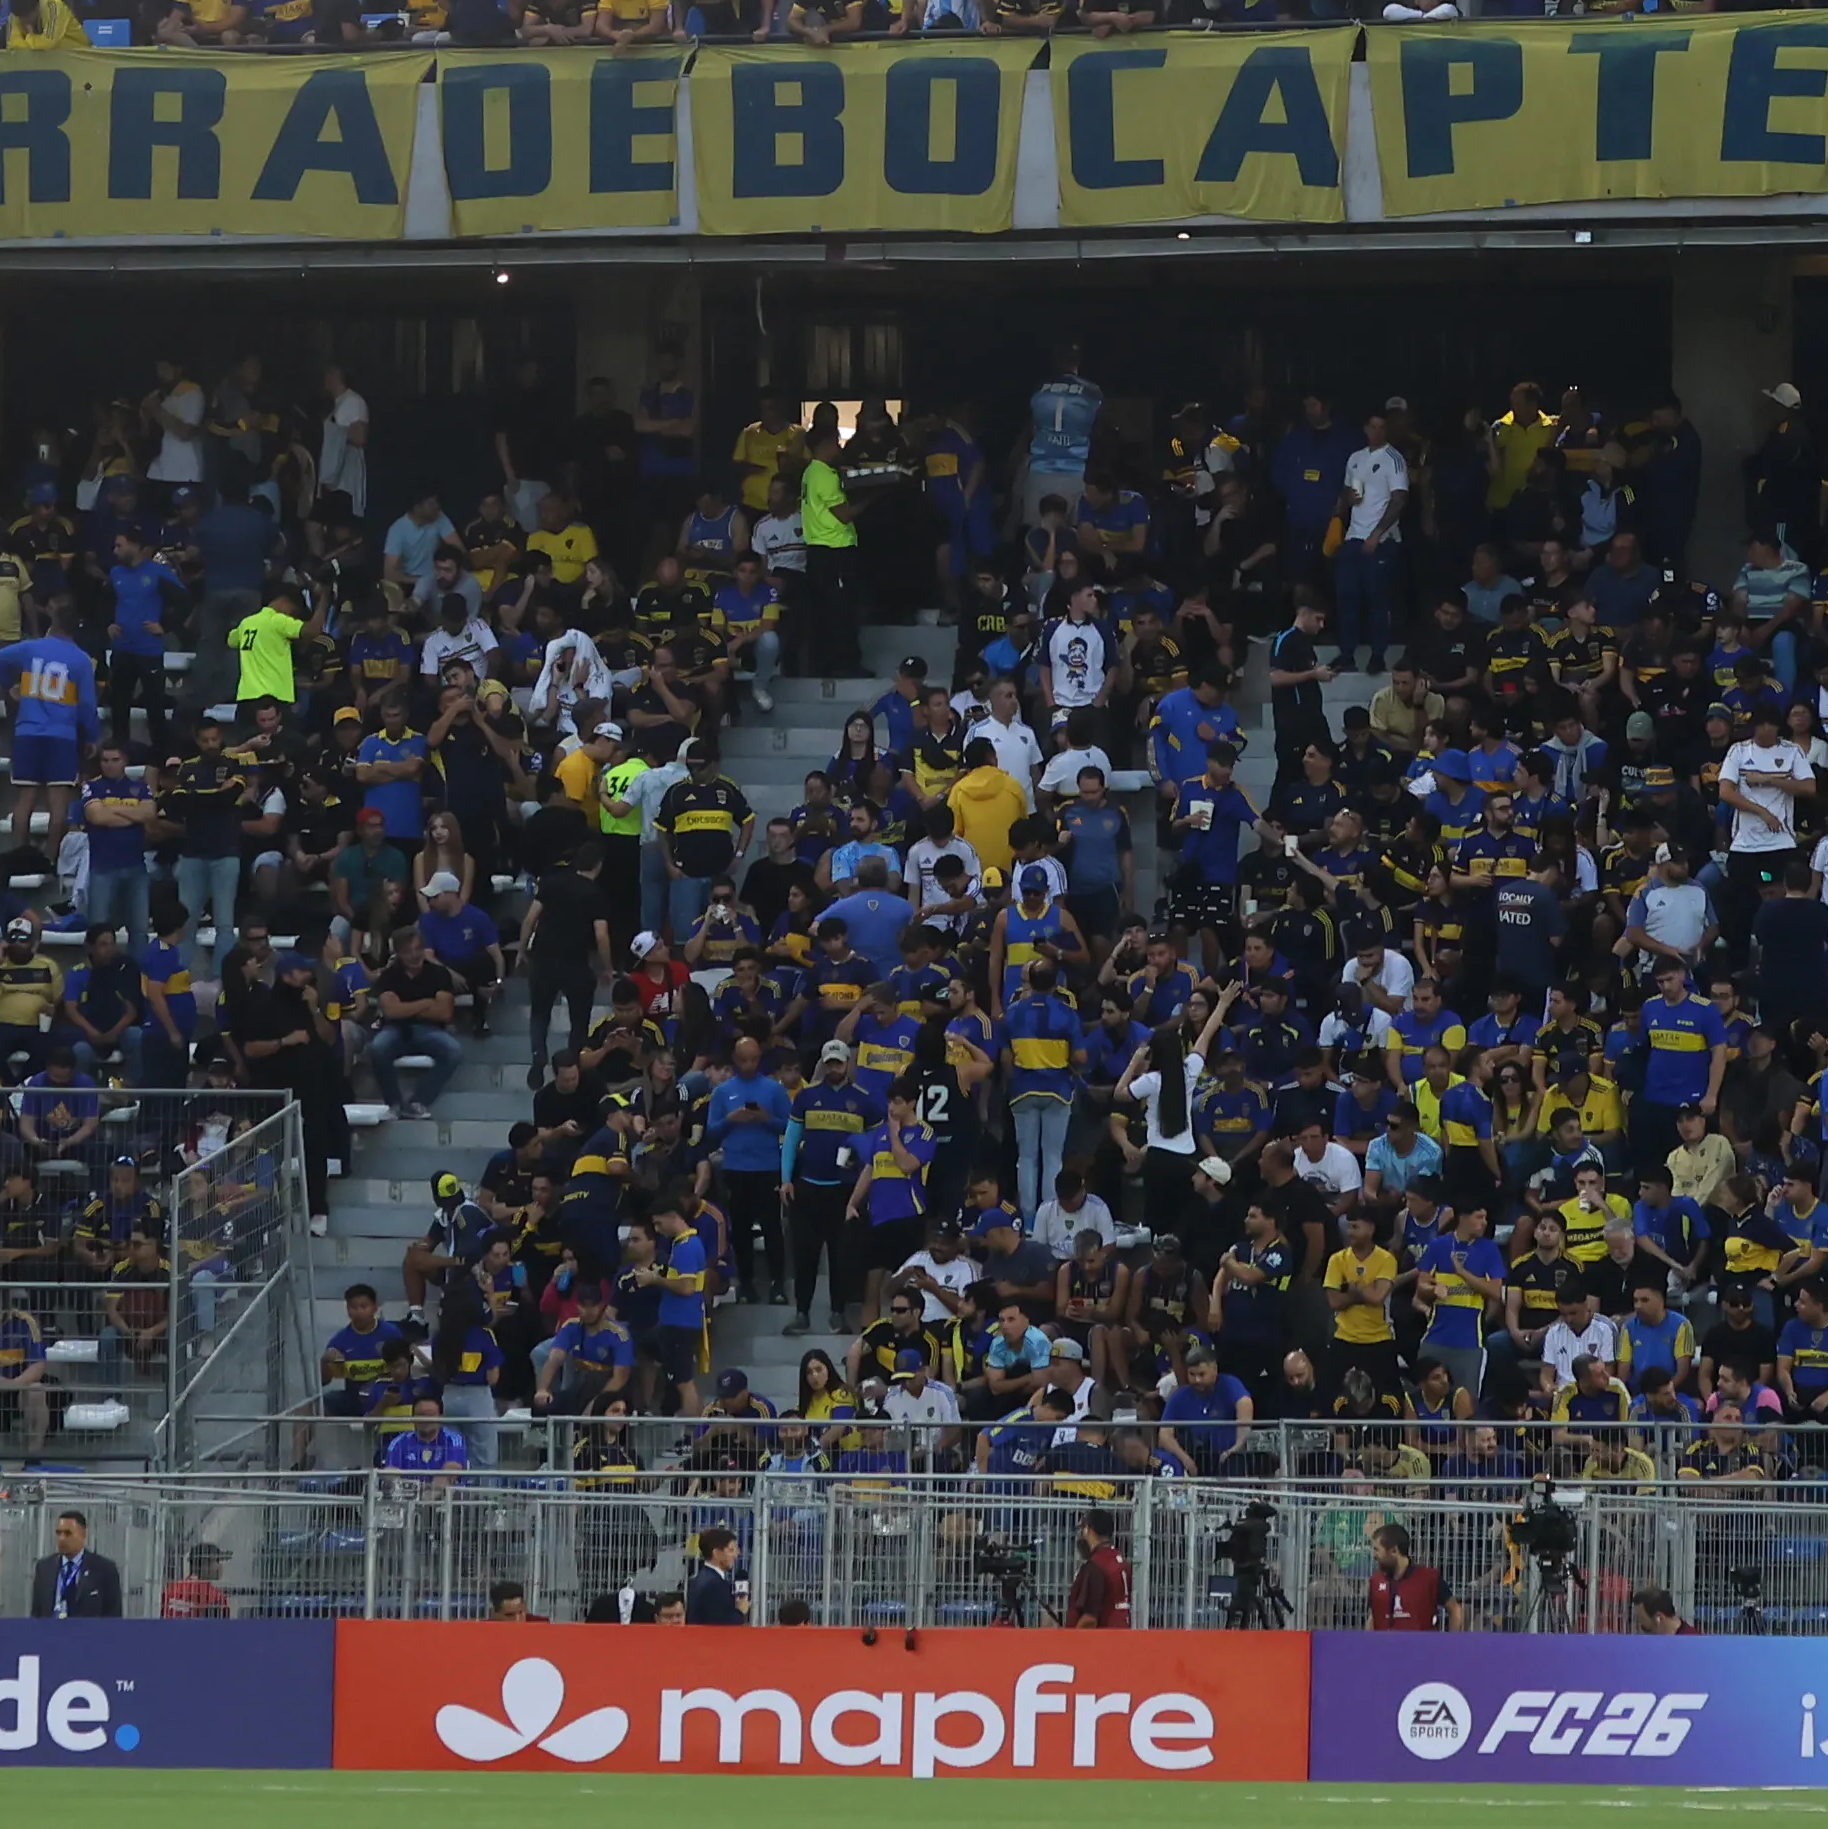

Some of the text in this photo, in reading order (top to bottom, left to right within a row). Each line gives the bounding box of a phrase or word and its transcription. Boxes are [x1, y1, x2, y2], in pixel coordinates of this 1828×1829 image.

[442, 57, 675, 199] DE
[732, 45, 1340, 199] BOCA
[241, 628, 258, 651] 27
[29, 657, 70, 701] 10
[607, 773, 629, 796] 34
[686, 815, 725, 826] betsson
[660, 1663, 1215, 1779] mapfre
[1411, 1700, 1455, 1723] EA
[1409, 1724, 1460, 1739] SPORTS
